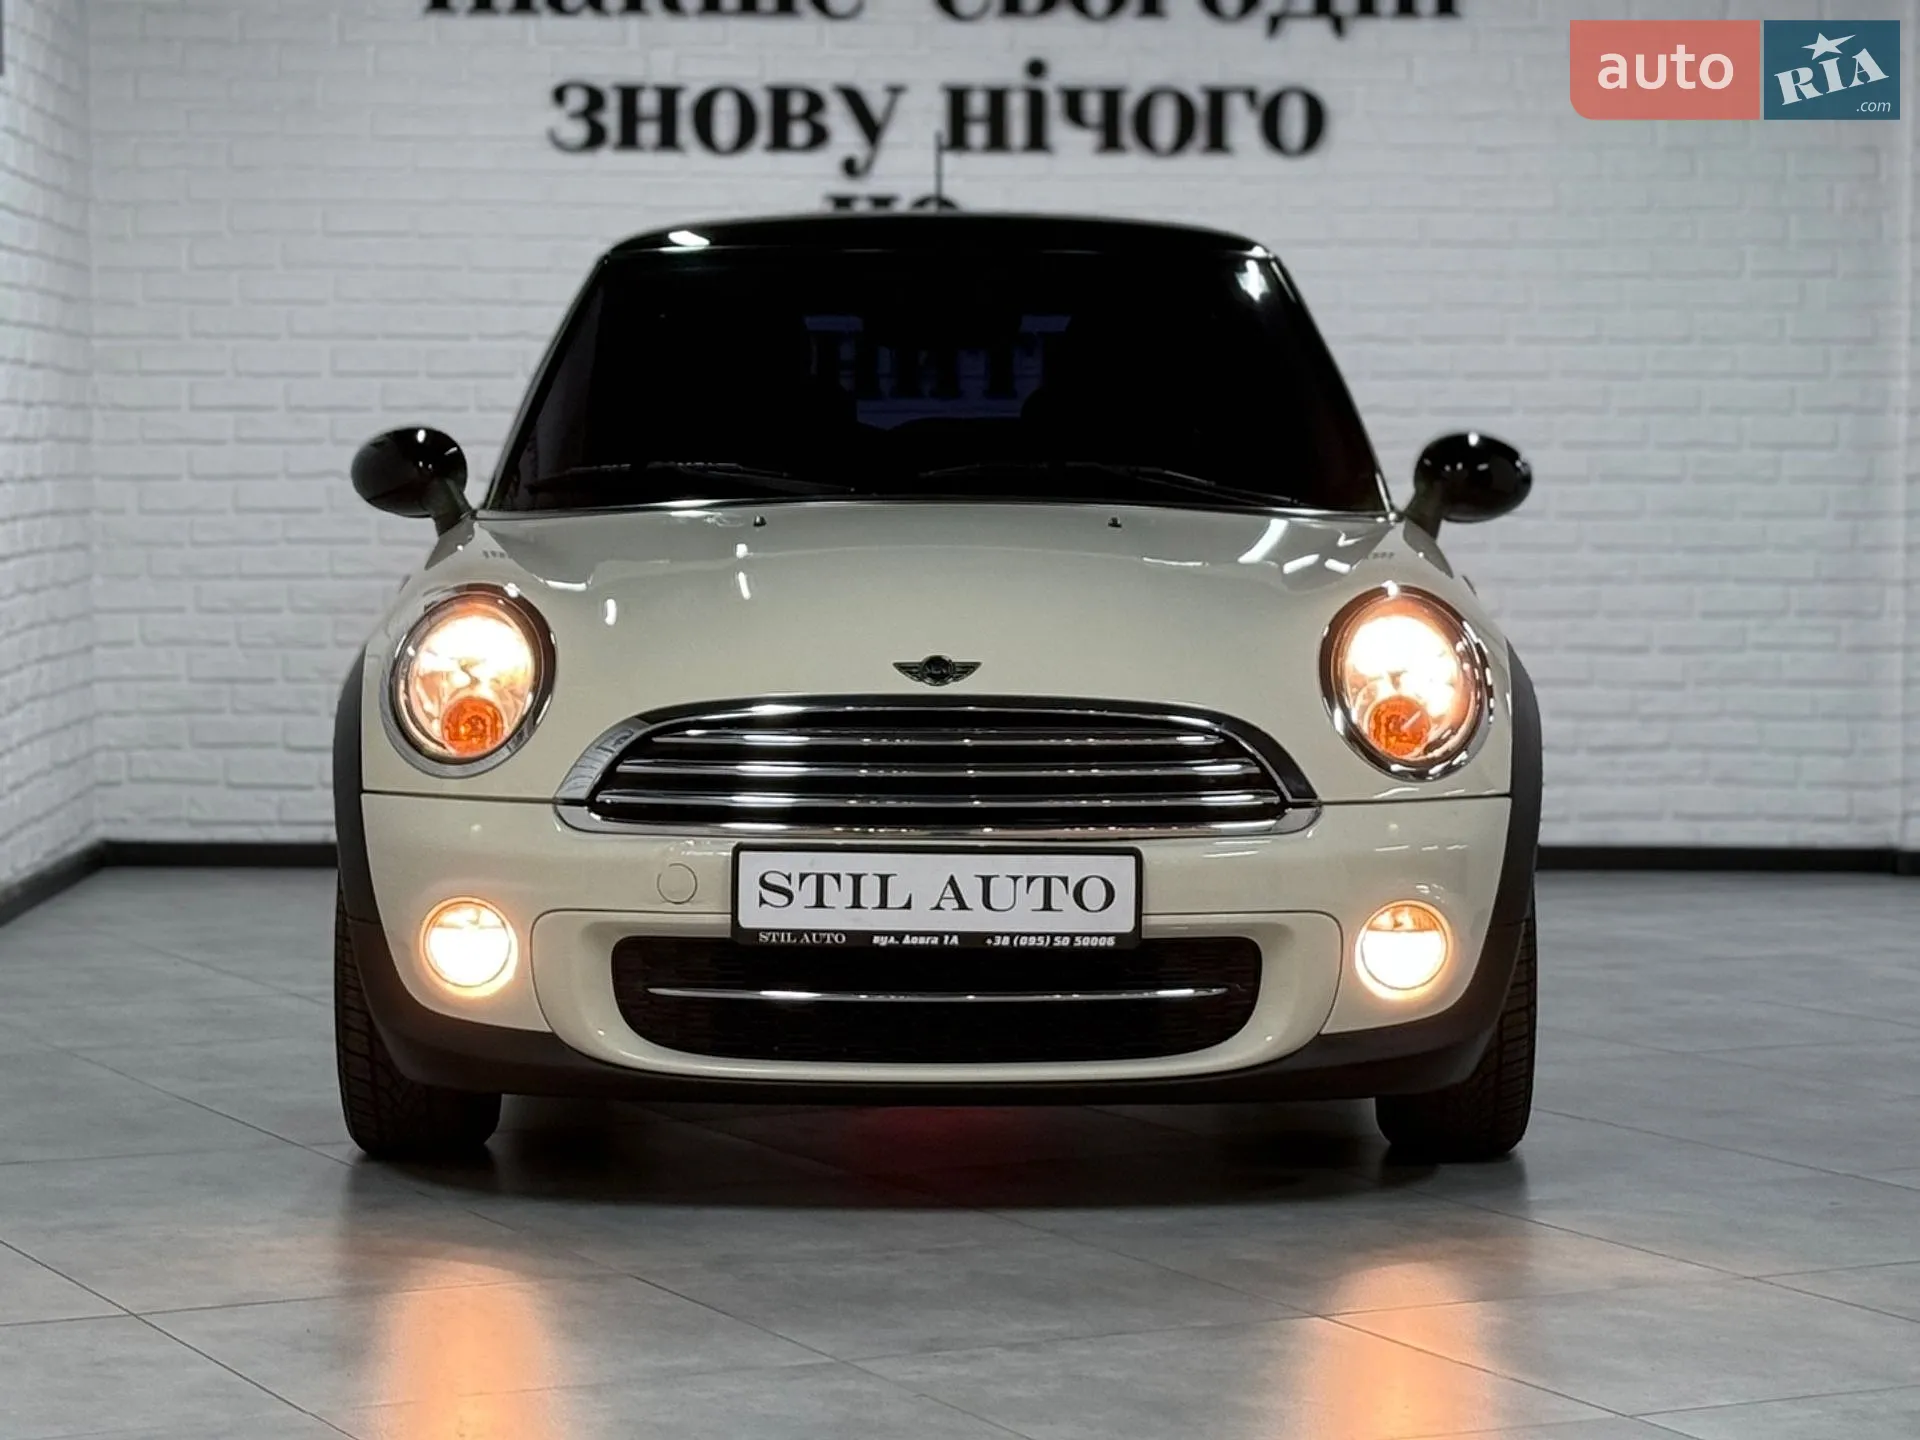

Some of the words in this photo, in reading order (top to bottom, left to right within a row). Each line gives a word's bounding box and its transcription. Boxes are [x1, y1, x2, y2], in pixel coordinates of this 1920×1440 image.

[548, 82, 907, 178] знову
[942, 58, 1328, 156] нічого
[758, 869, 912, 909] STIL
[929, 873, 1115, 913] AUTO
[758, 931, 796, 944] STIL
[799, 933, 846, 945] AUTO
[1053, 935, 1071, 947] 50
